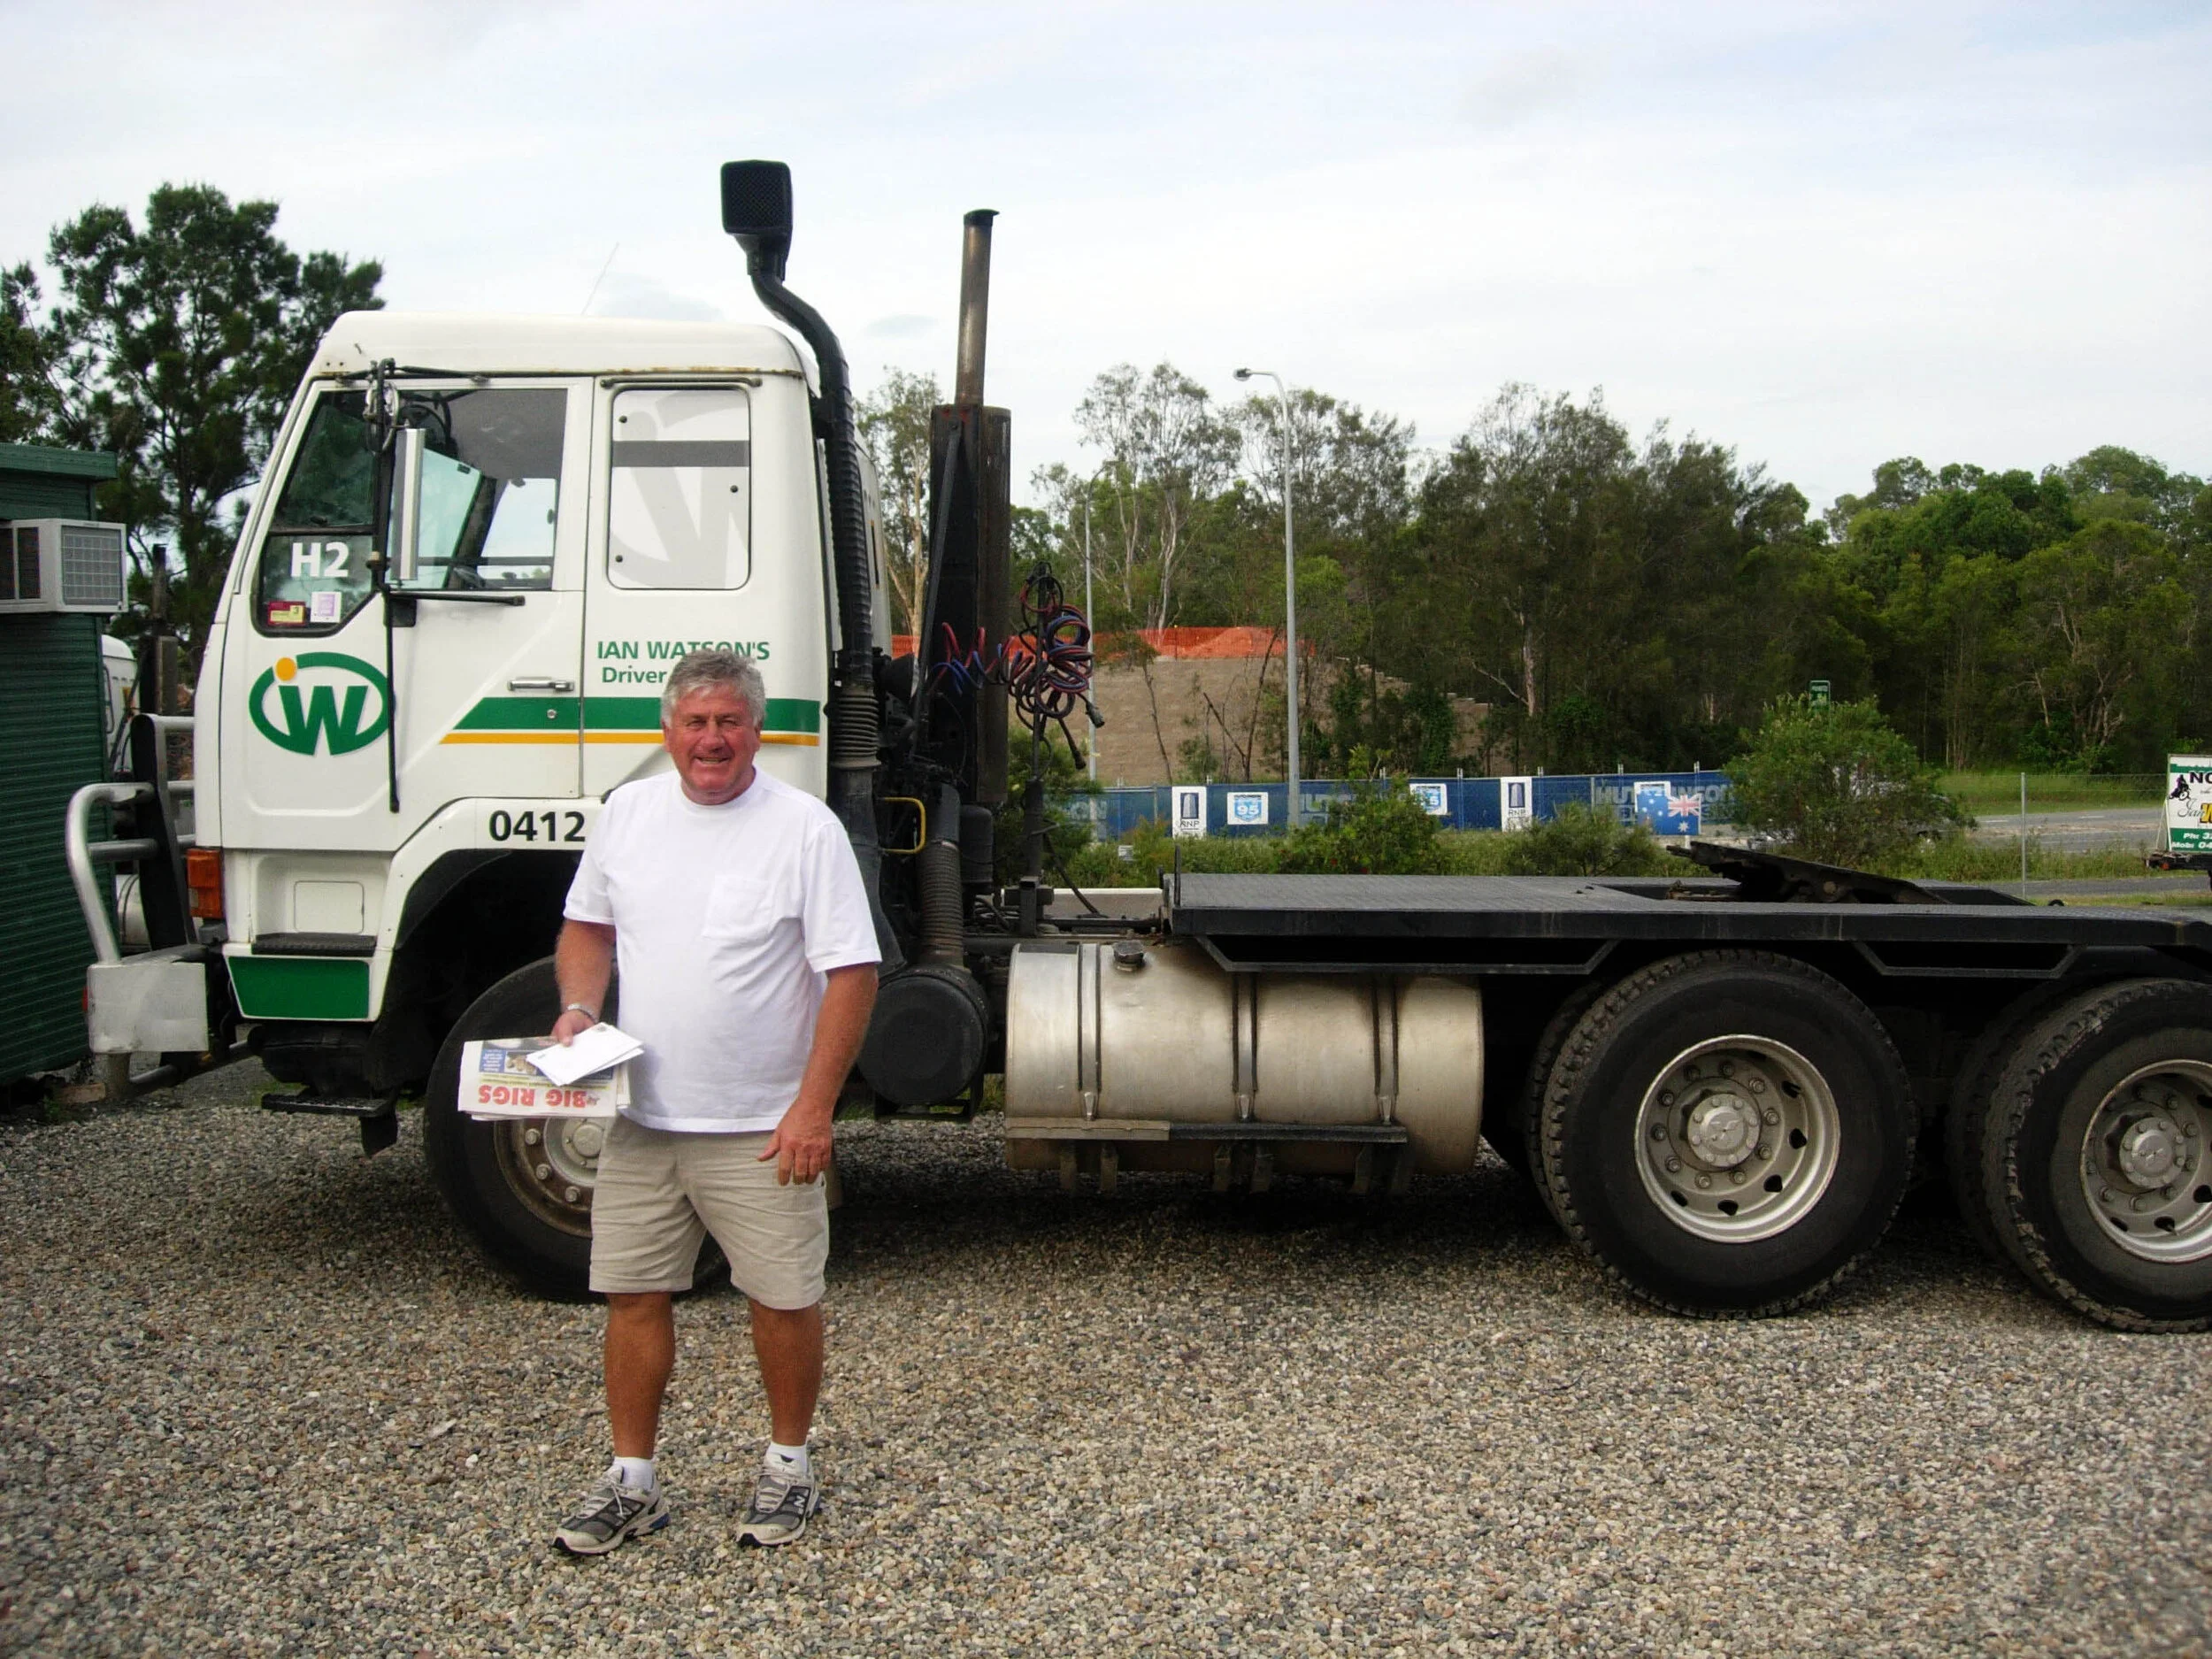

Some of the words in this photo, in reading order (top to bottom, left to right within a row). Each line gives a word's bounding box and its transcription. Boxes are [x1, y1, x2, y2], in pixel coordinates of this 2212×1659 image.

[290, 541, 349, 578] H2
[597, 641, 639, 660] IAN
[602, 664, 668, 684] Driver
[489, 810, 586, 842] 0412
[478, 1085, 535, 1107] RIGS
[545, 1088, 588, 1109] BIG
